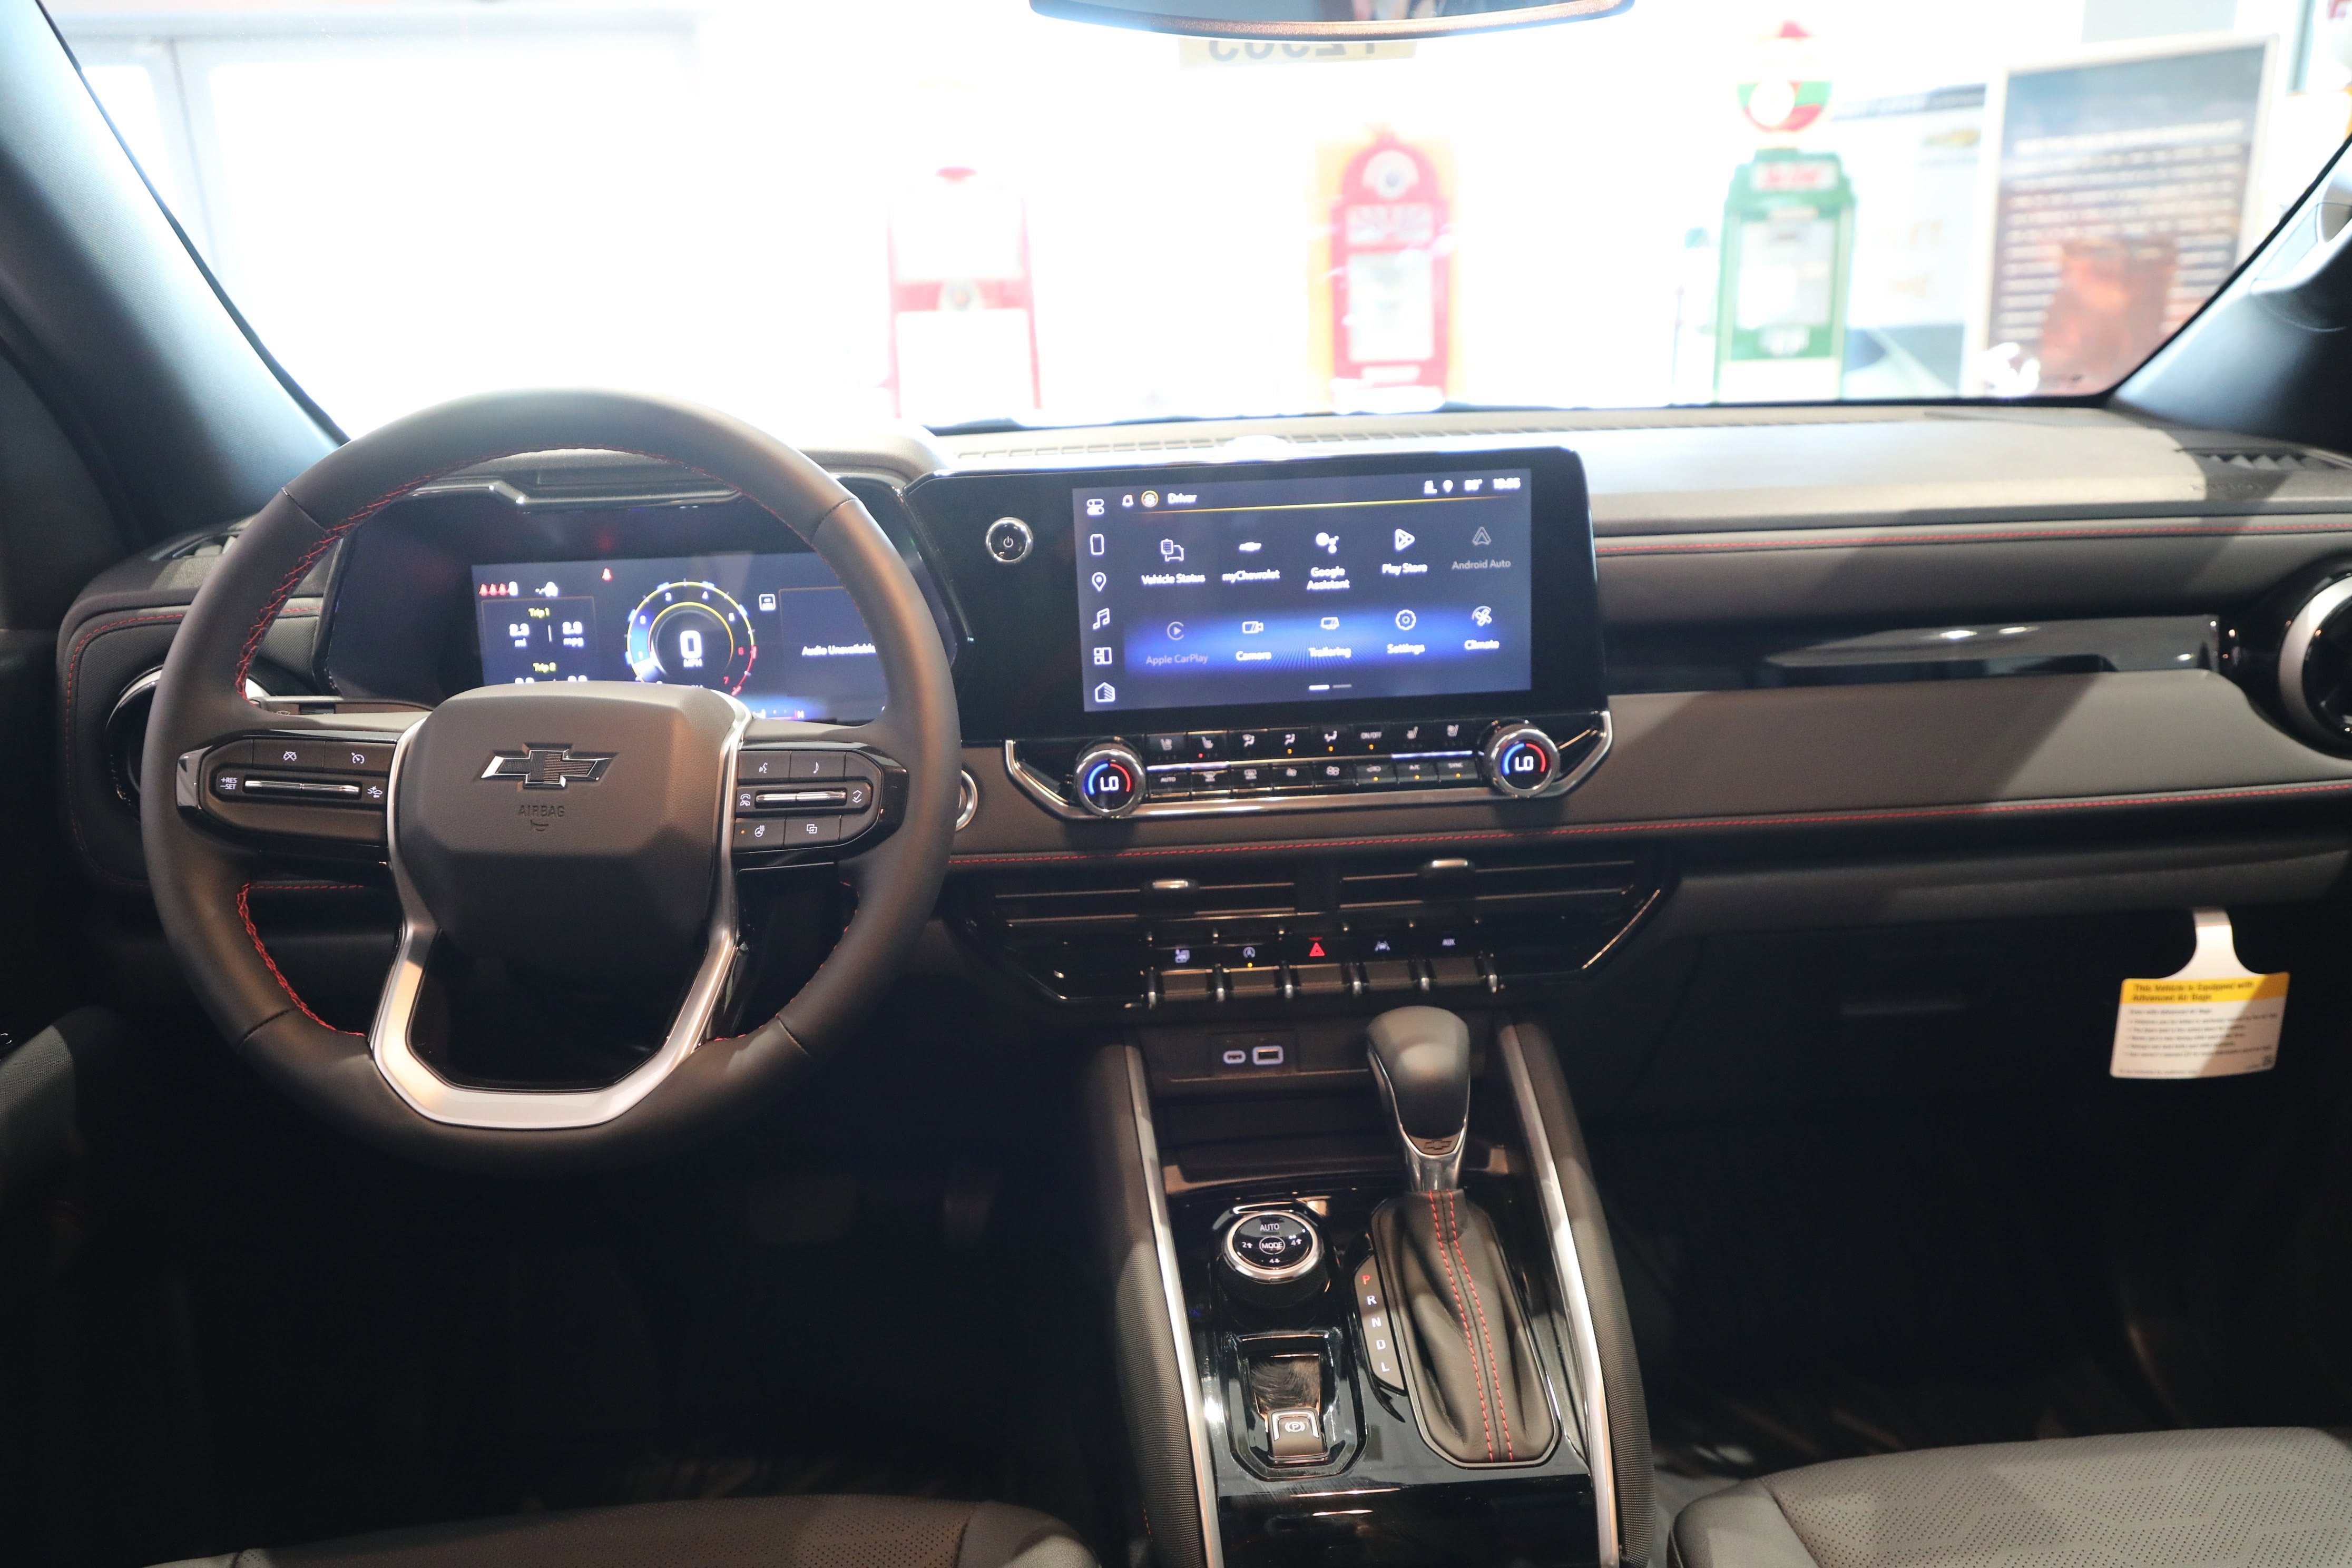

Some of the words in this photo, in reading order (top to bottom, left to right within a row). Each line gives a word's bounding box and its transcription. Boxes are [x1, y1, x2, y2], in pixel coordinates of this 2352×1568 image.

[1168, 493, 1198, 504] Driver
[1381, 563, 1402, 576] Play
[1402, 563, 1428, 574] Store
[1452, 560, 1488, 570] Android
[1489, 559, 1511, 568] Auto
[1222, 569, 1280, 583] myChevrolet
[1310, 566, 1346, 580] Google
[1141, 574, 1175, 585] Vehicle
[1175, 573, 1207, 584] Status
[1306, 580, 1350, 591] Assistant
[664, 592, 672, 602] 3
[701, 591, 709, 600] 4
[528, 607, 544, 619] Trip
[680, 630, 702, 659] 0
[1387, 643, 1426, 655] Settings
[1464, 639, 1500, 651] Climate
[738, 646, 744, 655] 6
[801, 646, 827, 656] Audio
[1236, 651, 1272, 661] Camera
[1308, 646, 1351, 658] Trailering
[683, 659, 703, 668] MPH
[1145, 655, 1172, 666] Apple
[1173, 653, 1208, 664] CarPlay
[533, 662, 549, 673] Trip
[723, 676, 730, 684] 7
[1515, 756, 1534, 771] LO
[1100, 776, 1119, 791] LO
[518, 805, 565, 817] AIRBAG
[1260, 1223, 1280, 1231] AUTO
[1361, 1275, 1371, 1285] P
[1367, 1295, 1377, 1306] R
[1371, 1317, 1382, 1328] N
[1376, 1339, 1386, 1350] D
[1381, 1361, 1390, 1373] L
